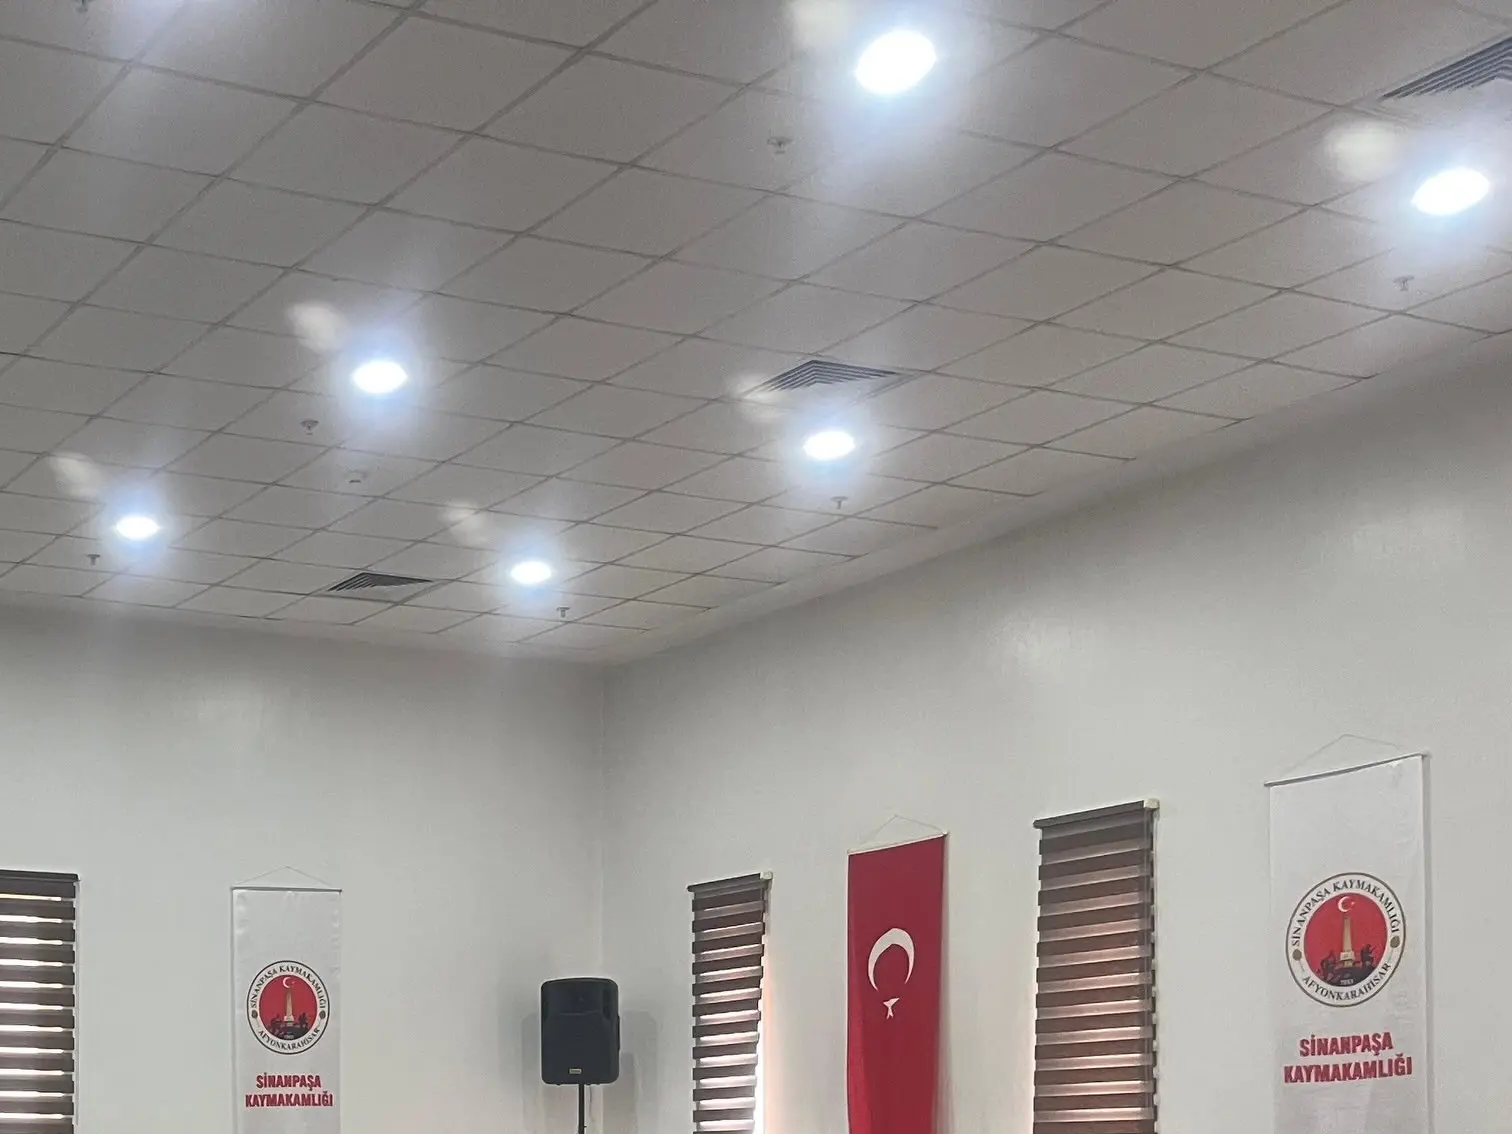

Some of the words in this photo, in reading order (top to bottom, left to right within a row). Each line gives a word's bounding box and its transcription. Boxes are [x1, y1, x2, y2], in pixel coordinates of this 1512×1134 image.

[1332, 879, 1401, 933] KAYMAKAMLIĞI
[1299, 1031, 1394, 1057] SİNANPAŞA
[256, 1072, 322, 1091] SİNANPAŞA
[1283, 1053, 1413, 1084] KAYMAKAMLIĞI
[245, 1090, 333, 1108] KAYMAKAMLIĞI
